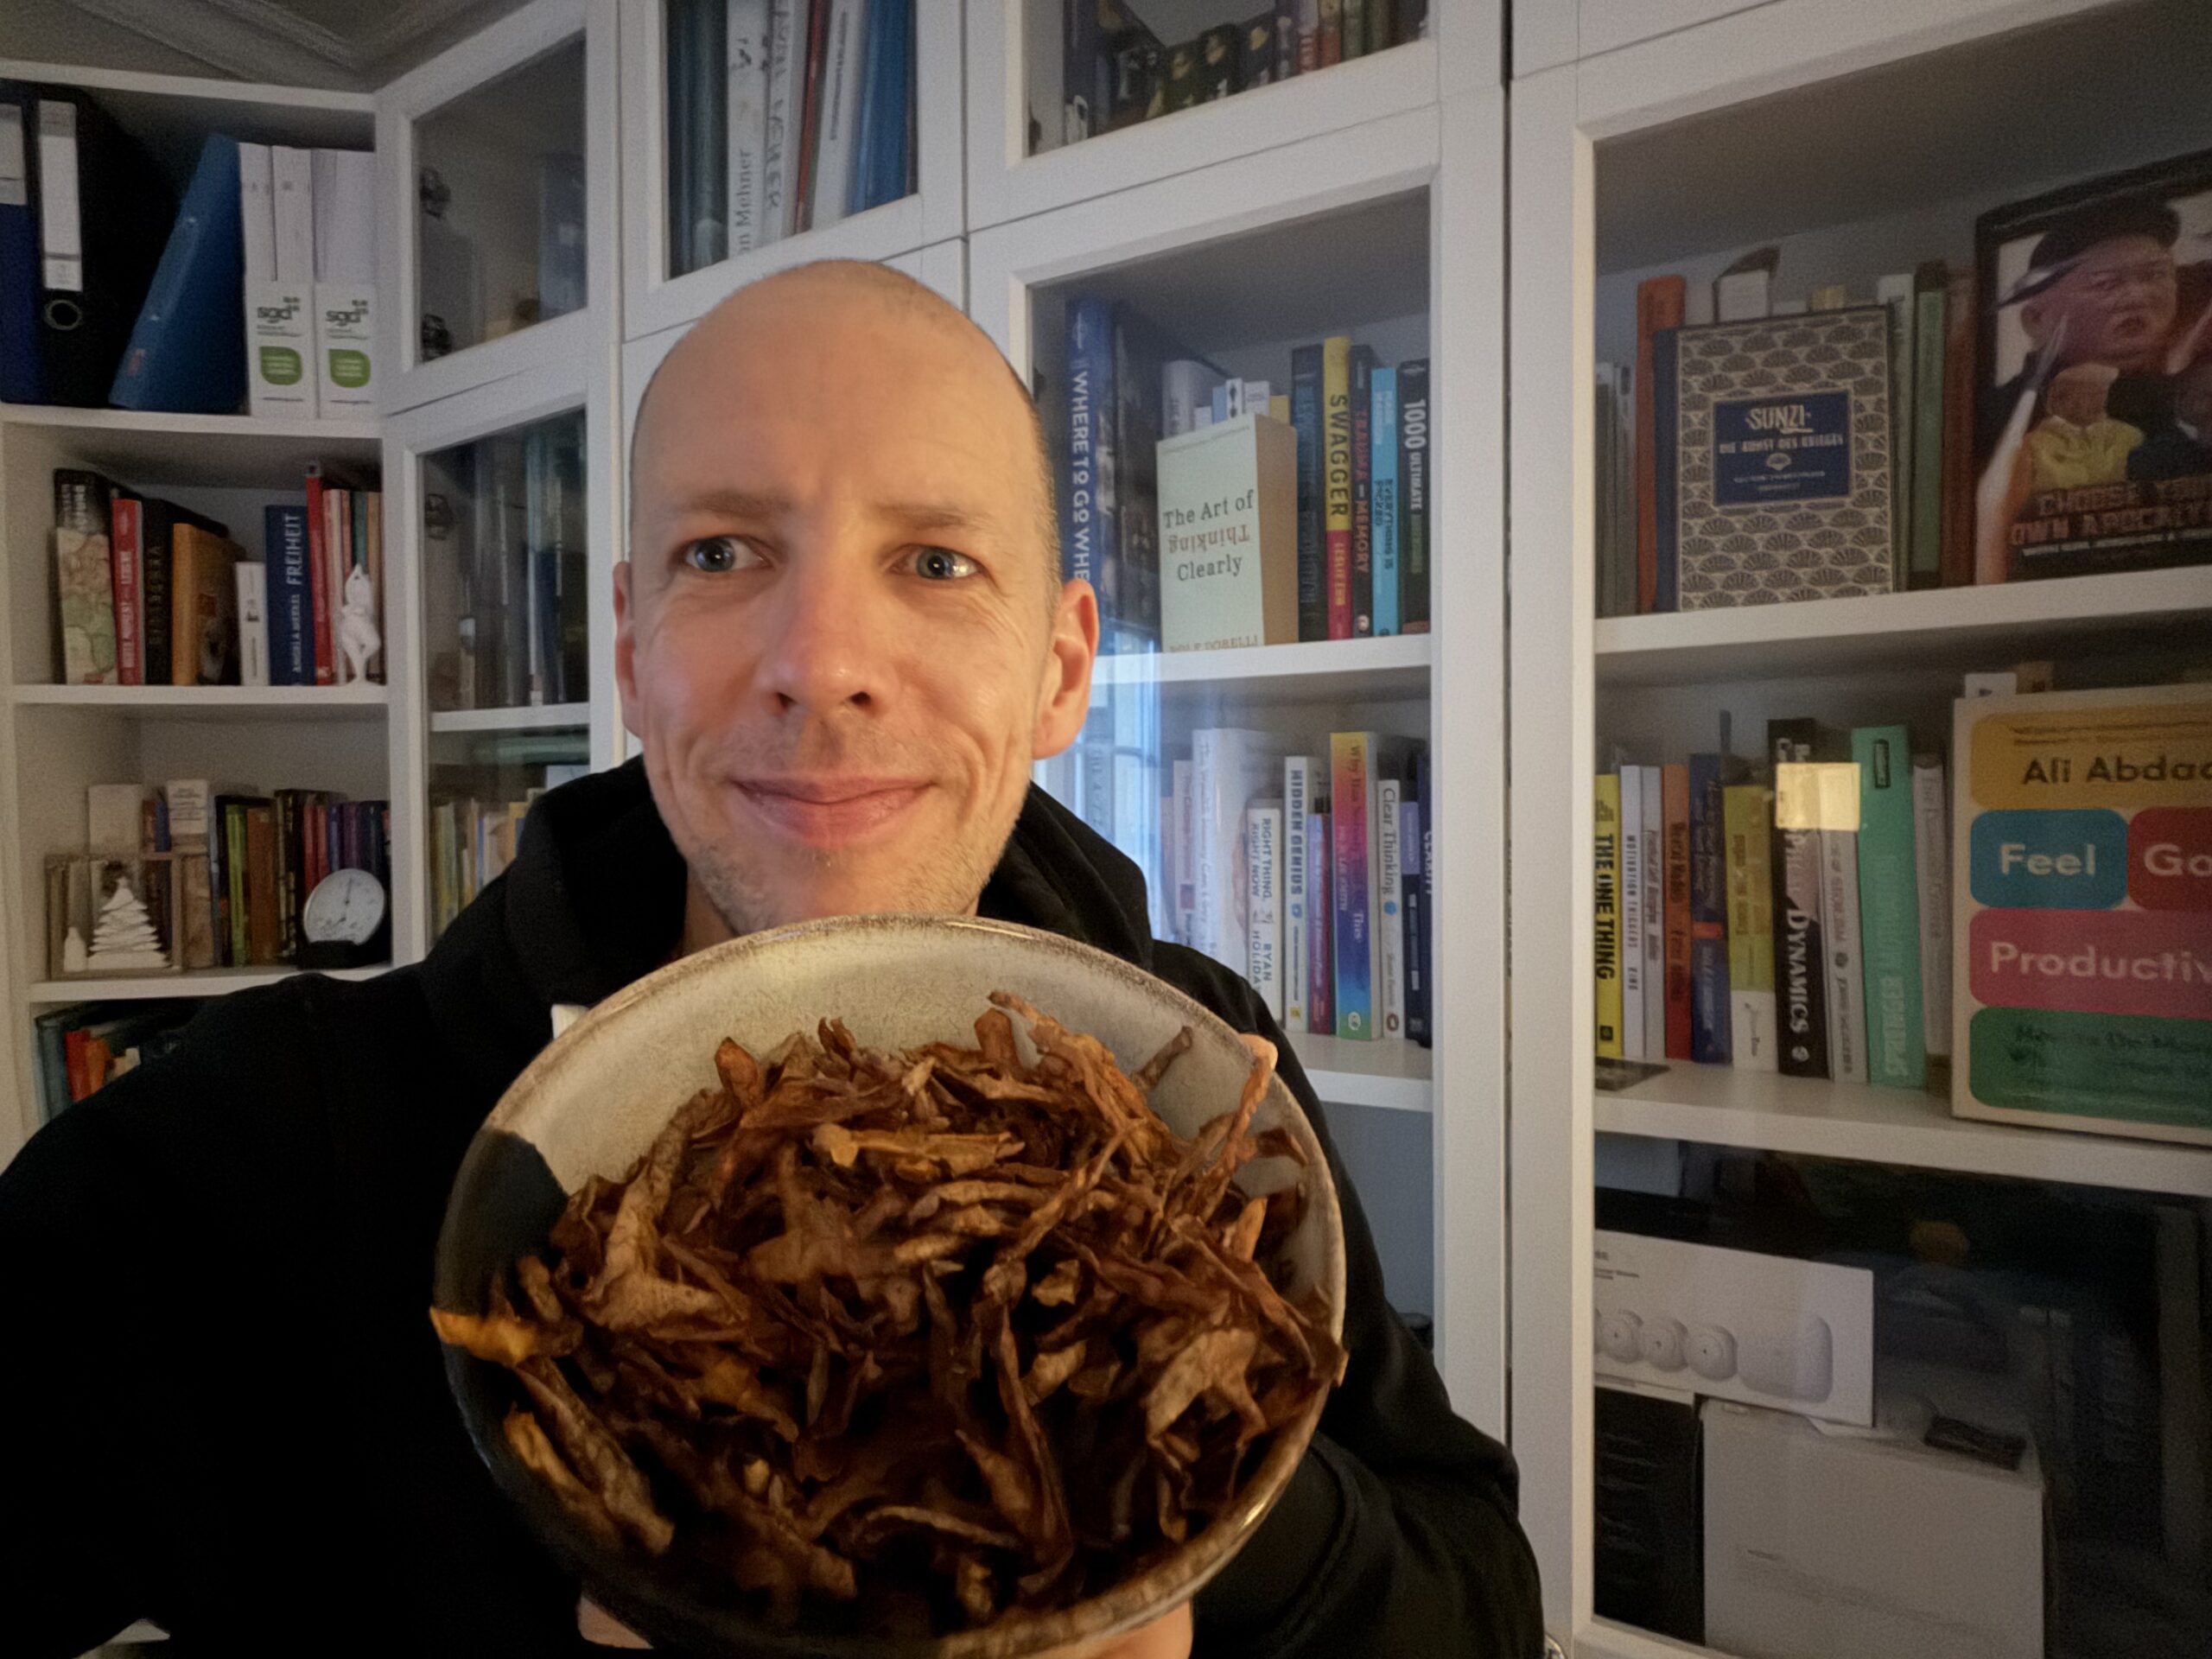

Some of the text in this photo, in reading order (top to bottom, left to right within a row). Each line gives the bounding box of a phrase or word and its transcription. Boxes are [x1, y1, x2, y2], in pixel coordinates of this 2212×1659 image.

[1071, 371, 1090, 453] WHERE
[1403, 397, 1428, 450] 1000
[1744, 404, 1814, 435] SUNZI
[1071, 456, 1090, 486] TO
[1329, 393, 1350, 517] SWAGGER
[1409, 452, 1423, 511] ULTIMATE
[1071, 490, 1090, 524] GO
[1162, 488, 1255, 529] The Art of
[282, 512, 304, 586] FREIHEIT
[1167, 524, 1251, 555] Thinking
[1354, 499, 1370, 574] MEMORY
[1177, 553, 1243, 582] Clearly
[2022, 755, 2073, 785] Ali
[1262, 817, 1273, 855] RIGHT
[1290, 770, 1304, 895] HIDDEN GENIUS
[1381, 787, 1398, 895] Clear Thinking
[1595, 834, 1615, 868] THE
[1626, 834, 1639, 896] MOTIVATION
[1999, 842, 2097, 876] Feel
[1251, 863, 1261, 897] NOW
[1262, 943, 1274, 982] RYAN
[1595, 918, 1616, 980] THING
[1785, 908, 1812, 1033] DYNAMICS
